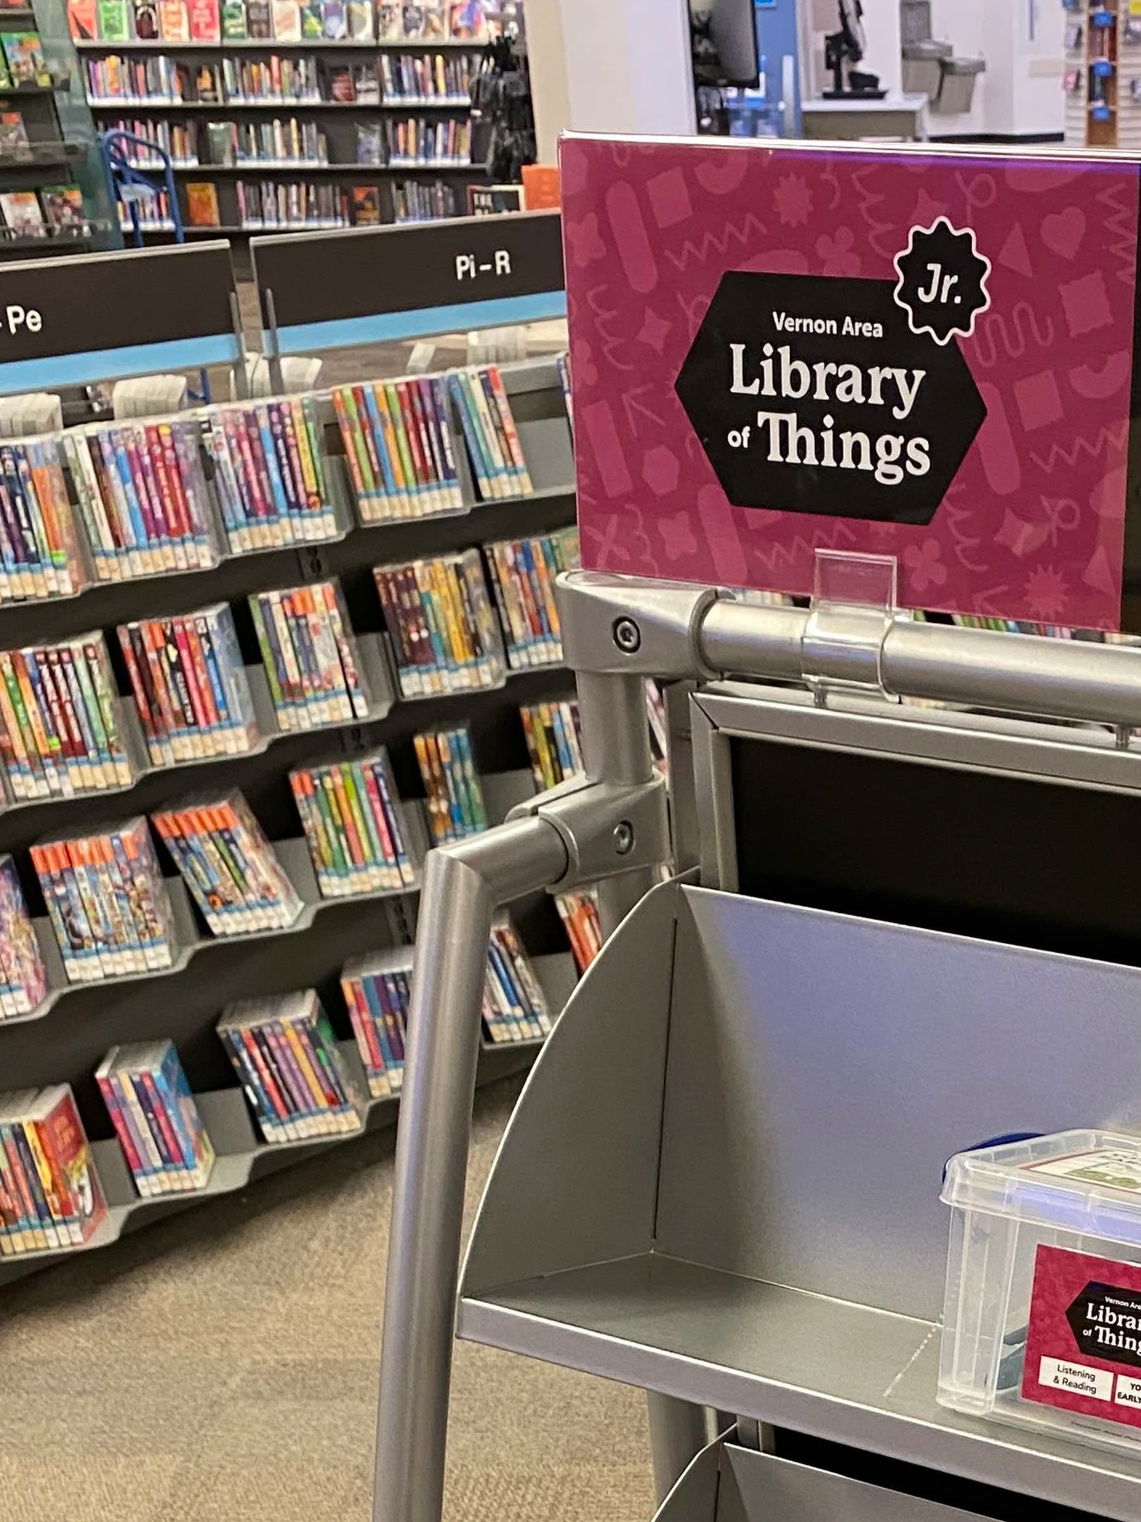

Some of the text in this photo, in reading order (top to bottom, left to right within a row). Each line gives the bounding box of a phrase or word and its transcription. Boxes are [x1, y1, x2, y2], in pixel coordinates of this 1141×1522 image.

[917, 262, 962, 304] Jr.
[7, 305, 42, 335] Pe
[773, 311, 883, 338] Vernon Area
[730, 342, 926, 419] Library
[727, 411, 931, 485] of Things
[1105, 1296, 1130, 1307] Vernon
[1083, 1328, 1092, 1337] of
[1053, 1376, 1097, 1395] & Reading
[1057, 1364, 1096, 1382] Listening
